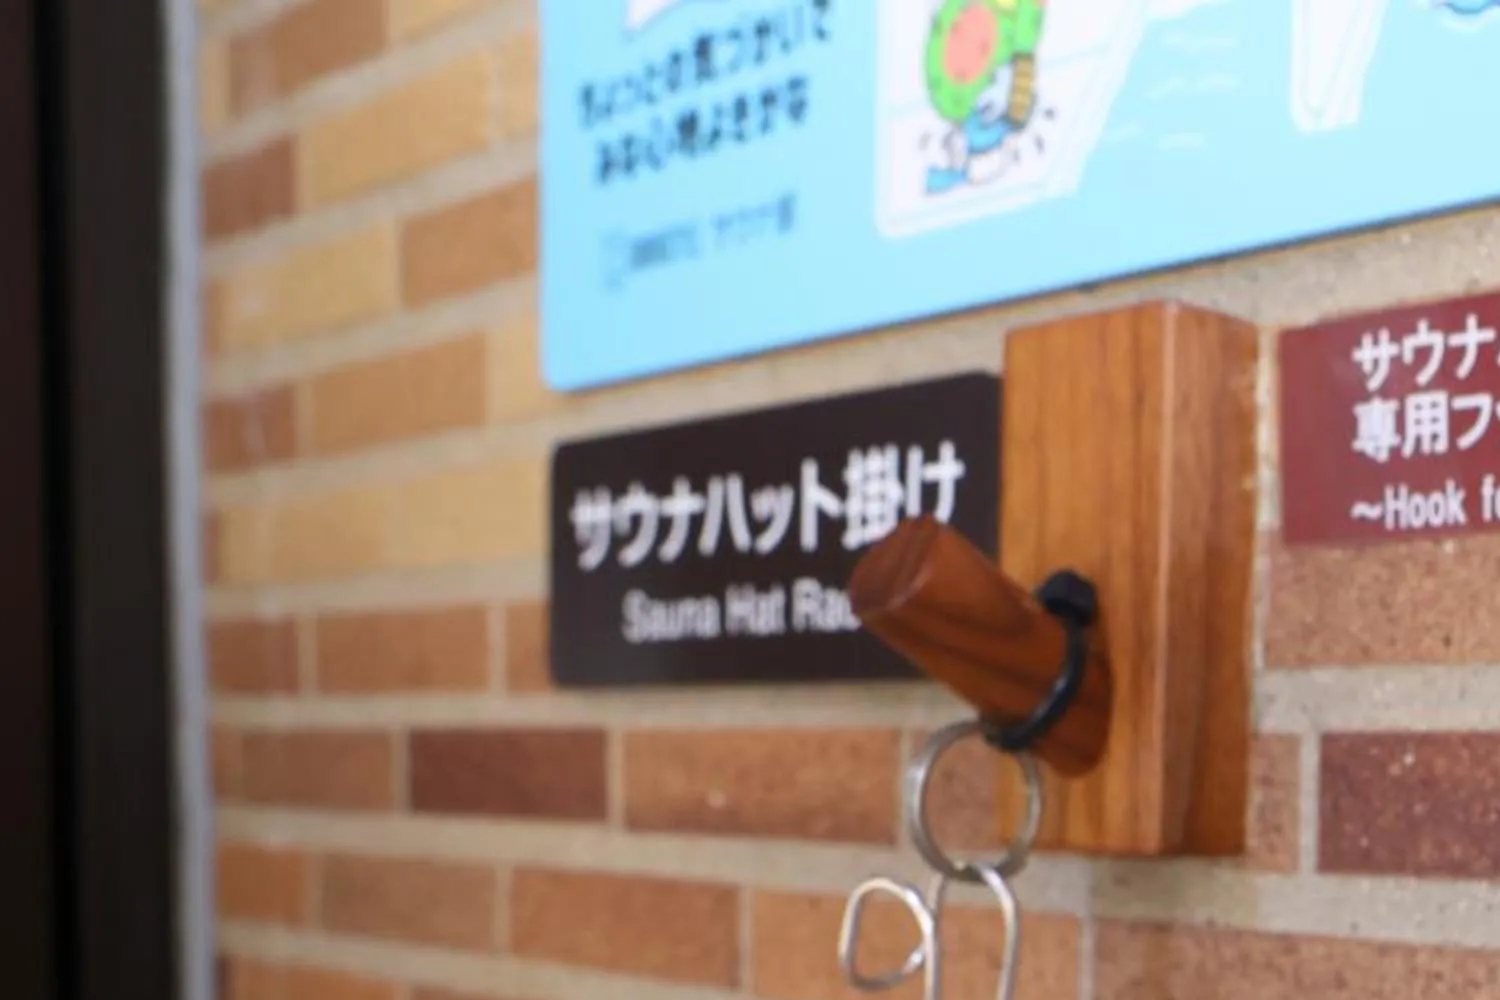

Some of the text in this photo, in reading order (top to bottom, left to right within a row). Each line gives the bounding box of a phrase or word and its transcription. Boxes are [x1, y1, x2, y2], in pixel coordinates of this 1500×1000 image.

[570, 440, 965, 571] サウナハット掛け
[621, 588, 722, 643] Sauna
[724, 582, 786, 636] Hat
